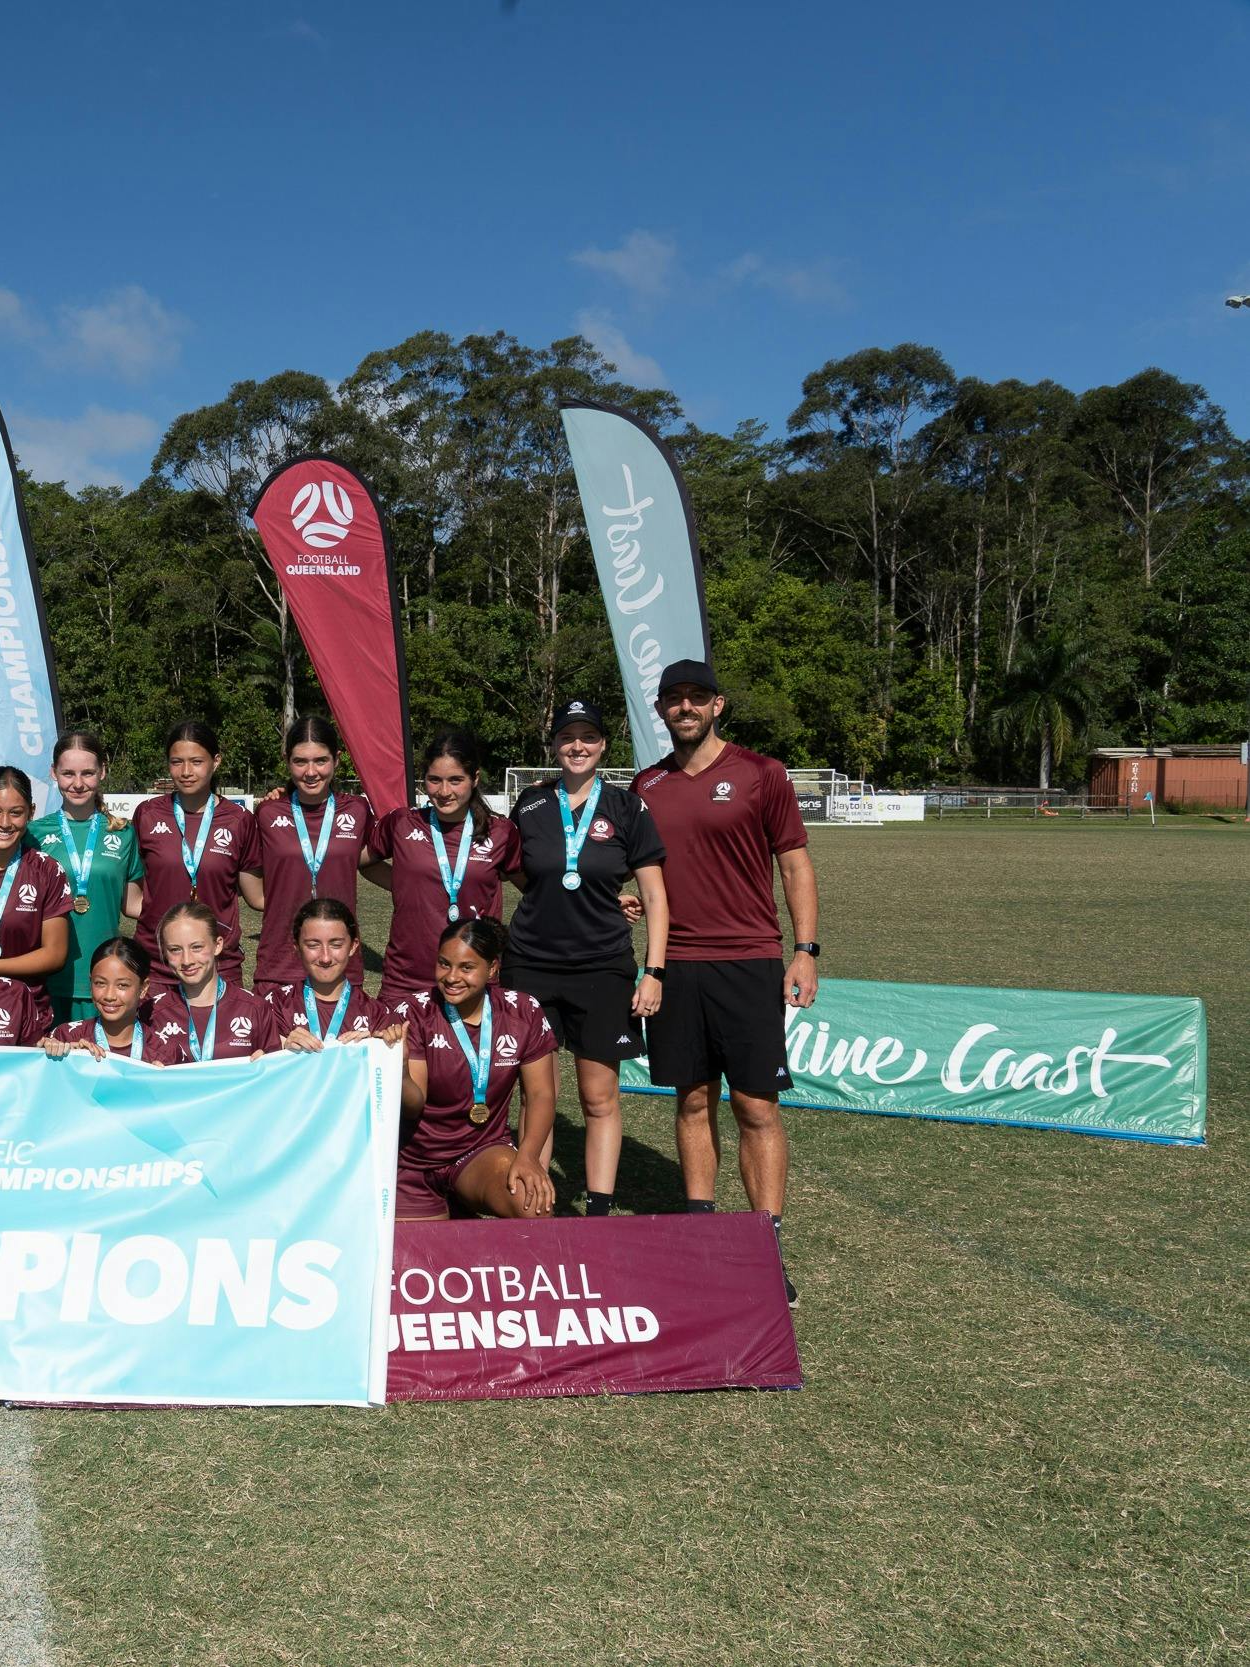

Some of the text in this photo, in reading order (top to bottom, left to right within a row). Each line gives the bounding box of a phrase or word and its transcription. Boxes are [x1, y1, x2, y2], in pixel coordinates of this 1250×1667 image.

[285, 564, 361, 576] QUEENSLAND
[297, 554, 349, 564] FOOTBALL
[784, 1004, 1172, 1098] hine Coast
[375, 1066, 386, 1122] CHAMPIO
[389, 1262, 602, 1308] OOTBALL
[387, 1304, 660, 1354] EENSLAND
